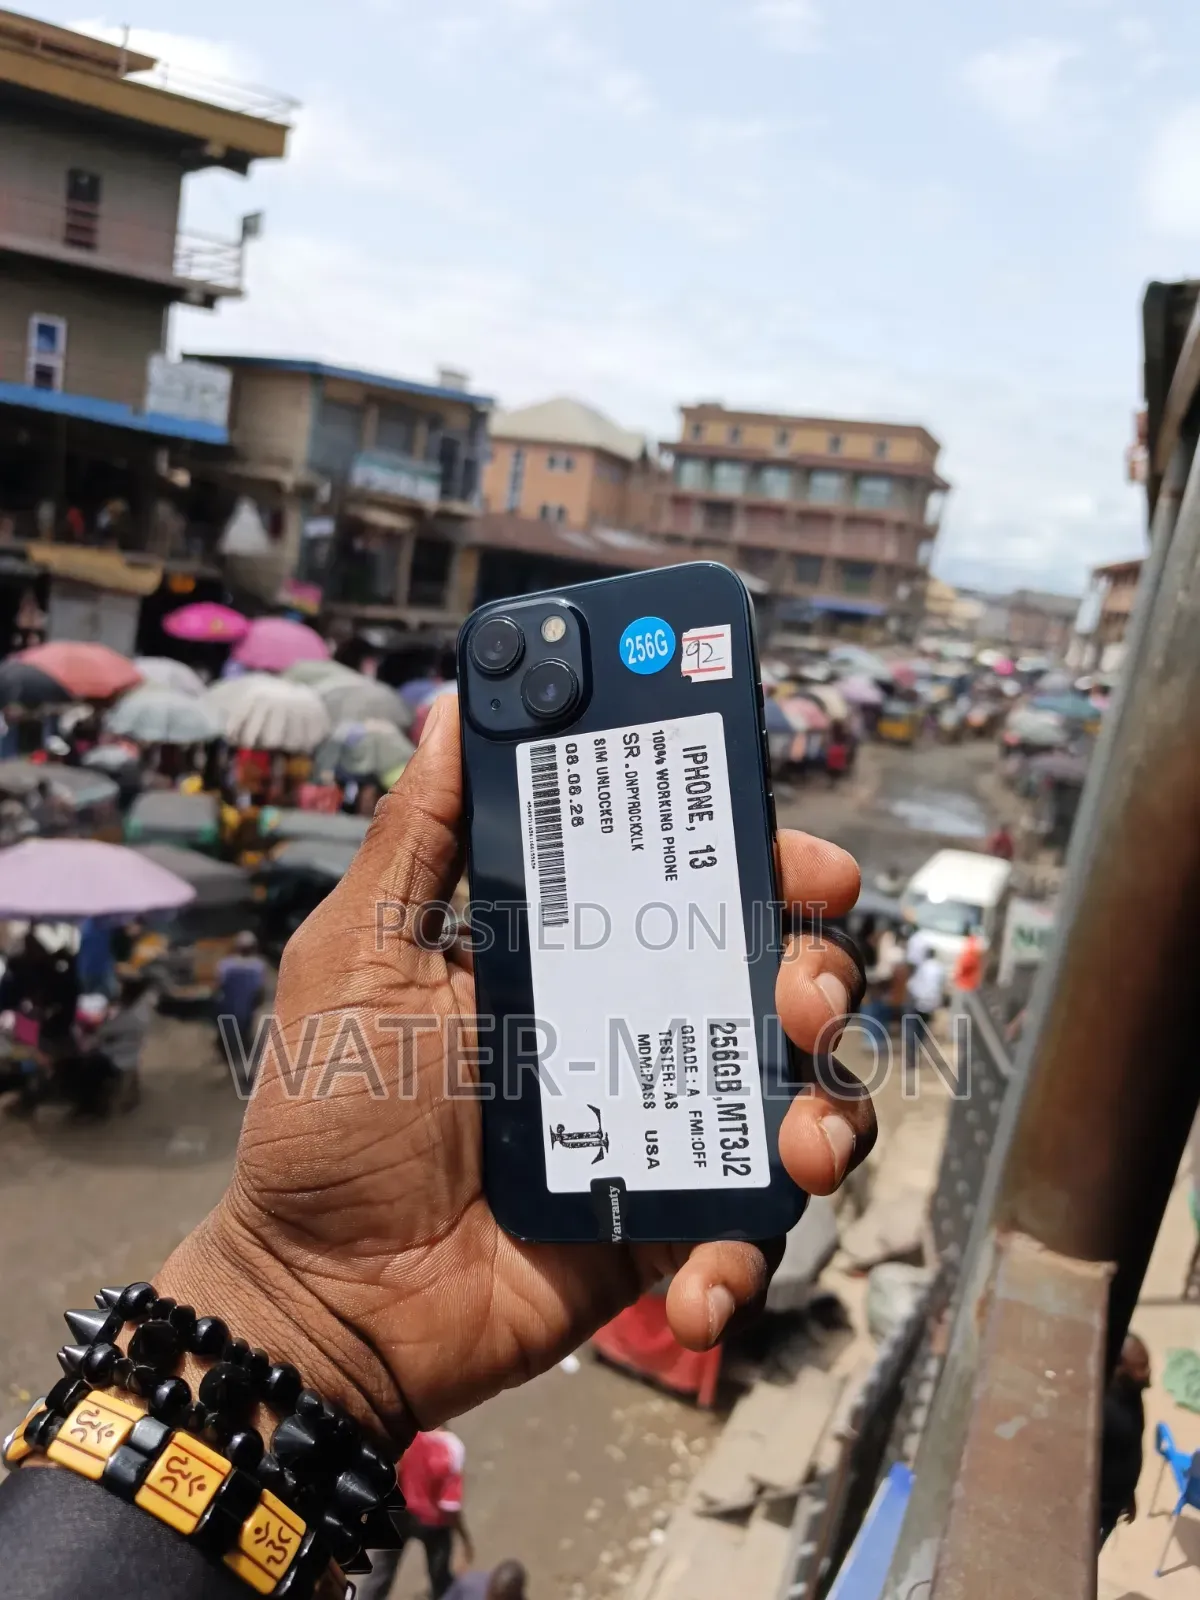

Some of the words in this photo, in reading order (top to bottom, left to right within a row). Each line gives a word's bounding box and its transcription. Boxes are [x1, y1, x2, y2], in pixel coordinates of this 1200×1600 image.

[626, 629, 668, 664] 256G
[686, 640, 724, 669] 92
[593, 738, 608, 762] SIM
[652, 729, 667, 765] 100%
[596, 767, 614, 834] UNLOCKED
[656, 768, 674, 832] WORKING
[682, 745, 714, 832] IPHONE,
[662, 837, 678, 882] PHONE
[688, 844, 718, 870] 13
[637, 1033, 656, 1110] MDM:PASS
[659, 1029, 676, 1087] TESTER:
[664, 1091, 678, 1110] AS
[644, 1130, 660, 1169] USA
[688, 1110, 707, 1168] FMI:OFF
